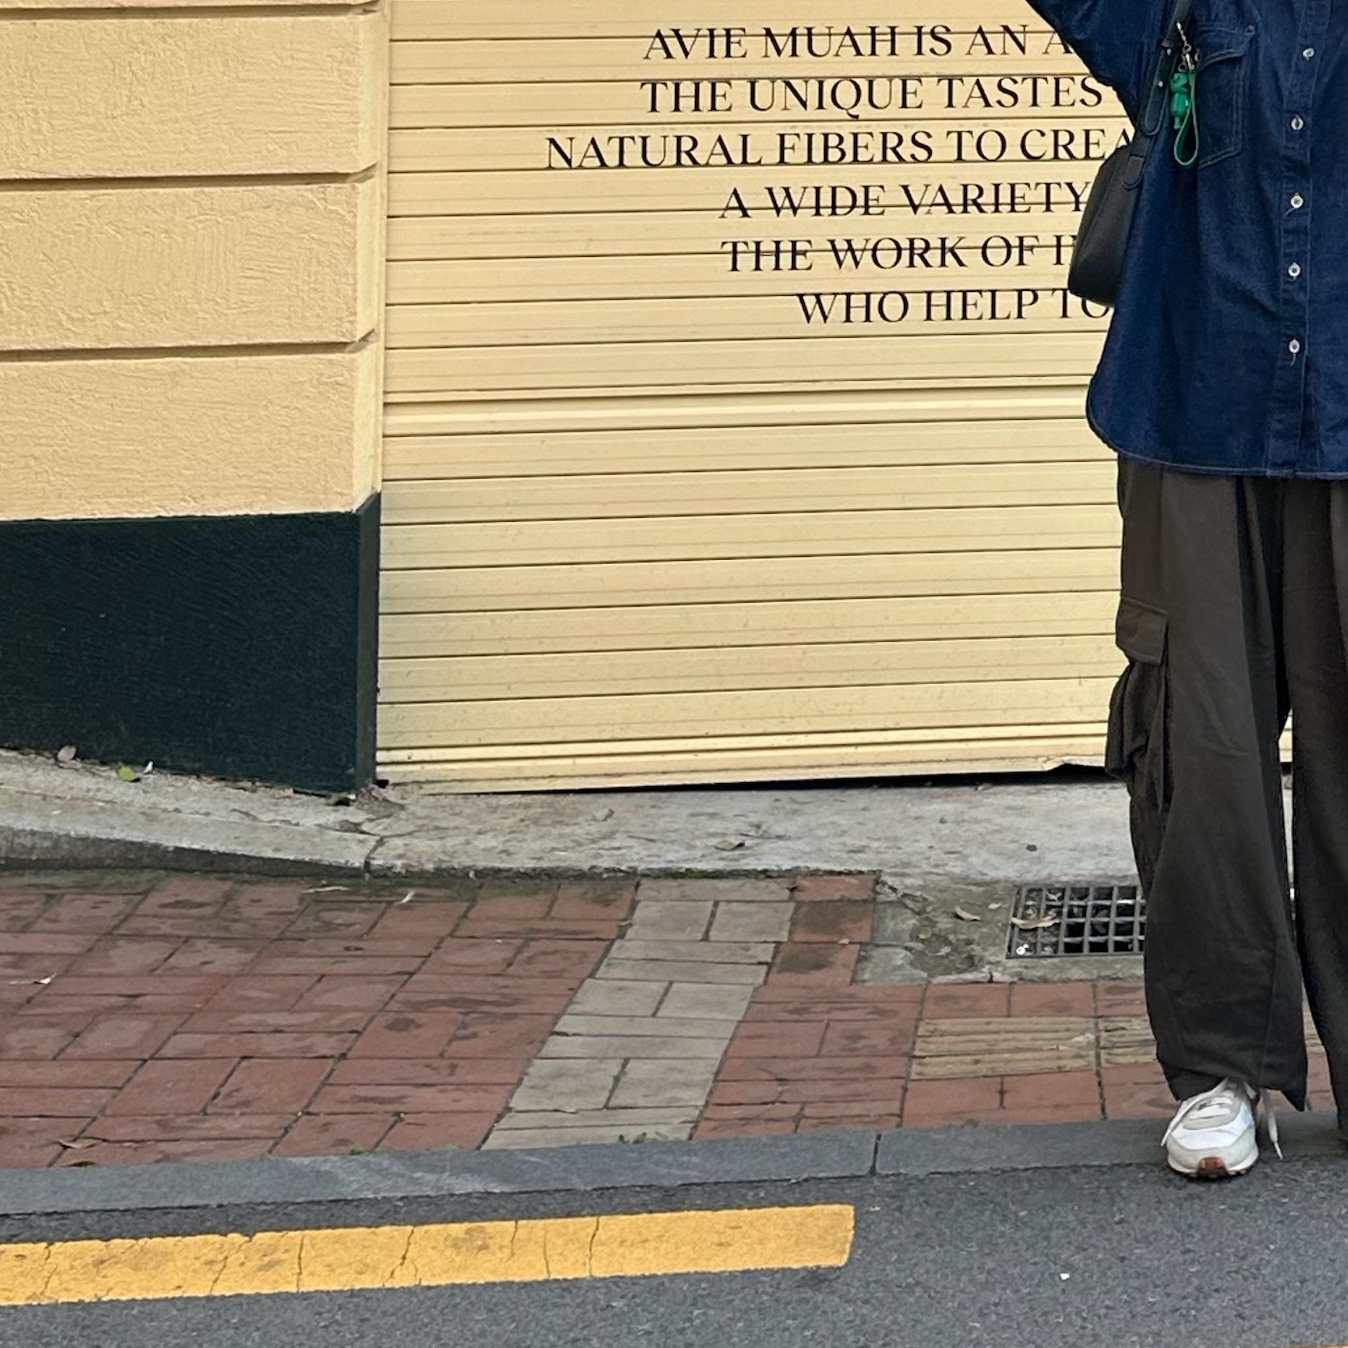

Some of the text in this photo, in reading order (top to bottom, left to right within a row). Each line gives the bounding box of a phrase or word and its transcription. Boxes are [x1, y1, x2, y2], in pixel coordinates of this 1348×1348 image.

[643, 27, 748, 60] AVIE
[761, 25, 898, 58] MUAH
[914, 24, 952, 57] IS
[966, 24, 1029, 56] AN
[640, 79, 734, 113] THE
[746, 76, 924, 119] UNIQUE
[937, 75, 1103, 109] TASTES
[545, 134, 763, 170] NATURAL
[776, 130, 933, 167] FIBERS
[946, 129, 1007, 163] TO
[718, 187, 752, 220] A
[765, 185, 886, 218] WIDE
[899, 182, 1091, 216] VARIETY
[721, 239, 812, 273] THE
[826, 236, 968, 271] WORK
[980, 235, 1040, 268] OF
[796, 291, 909, 325] WHO
[923, 289, 1039, 324] HELP
